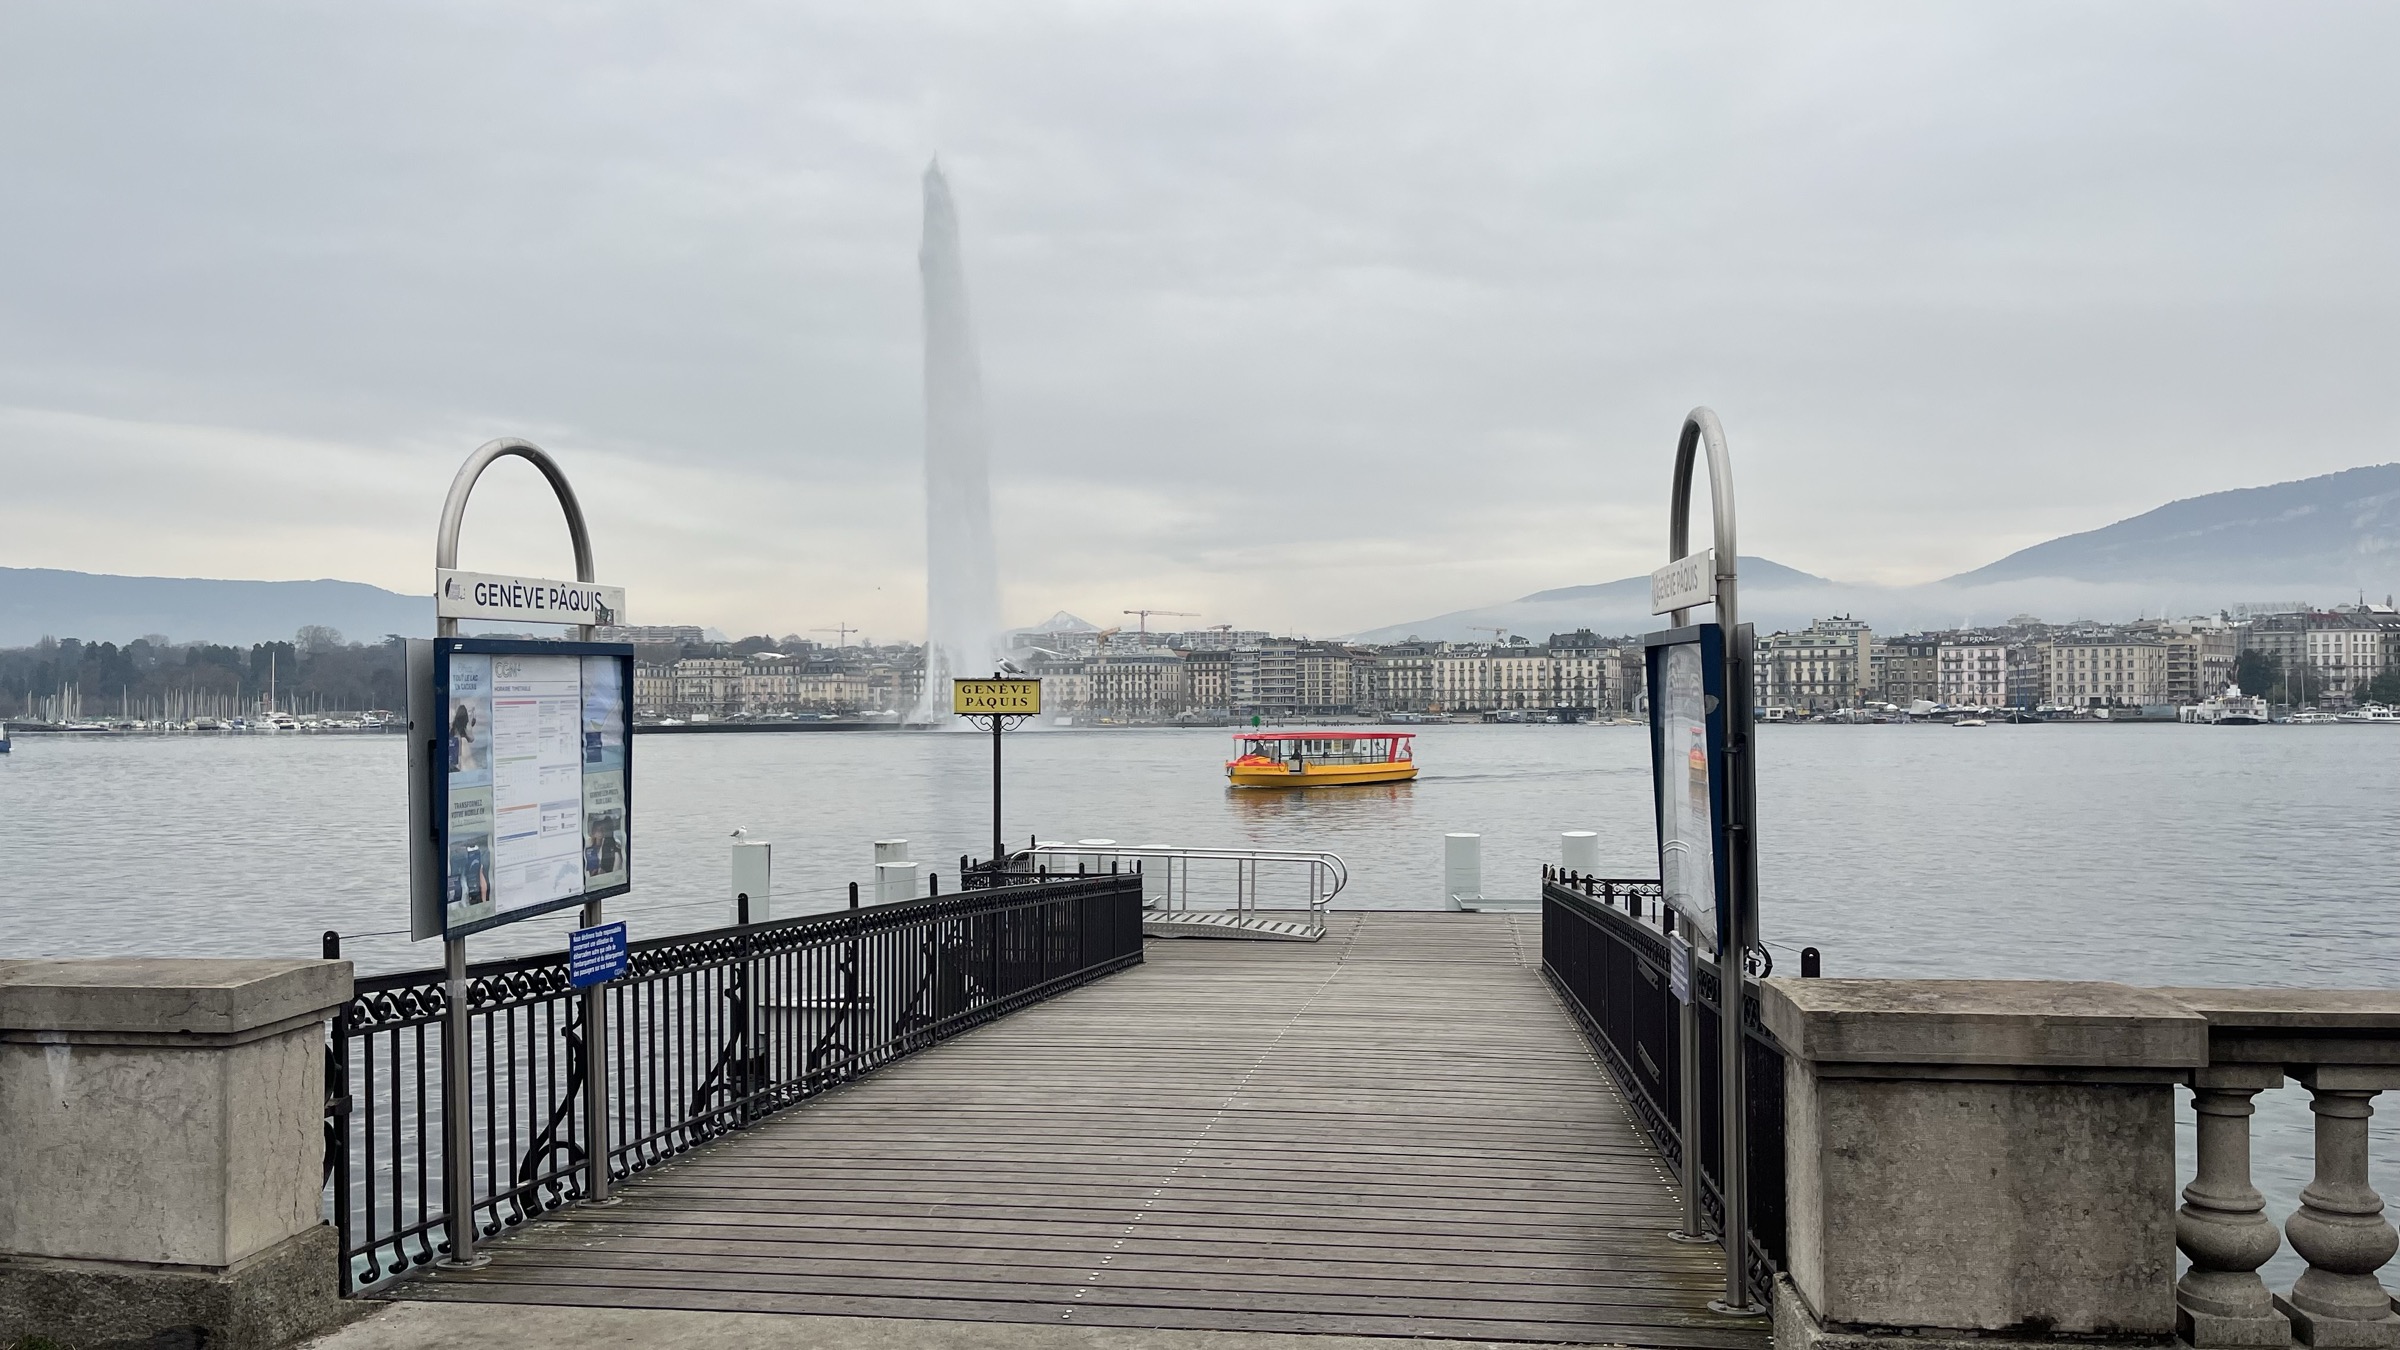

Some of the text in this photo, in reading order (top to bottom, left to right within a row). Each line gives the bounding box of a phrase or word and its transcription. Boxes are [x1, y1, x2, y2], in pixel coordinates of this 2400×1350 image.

[1677, 564, 1698, 595] PÂQUIS
[474, 580, 602, 612] GENÈVE PÂQUIS
[962, 683, 1032, 694] GENÈVE
